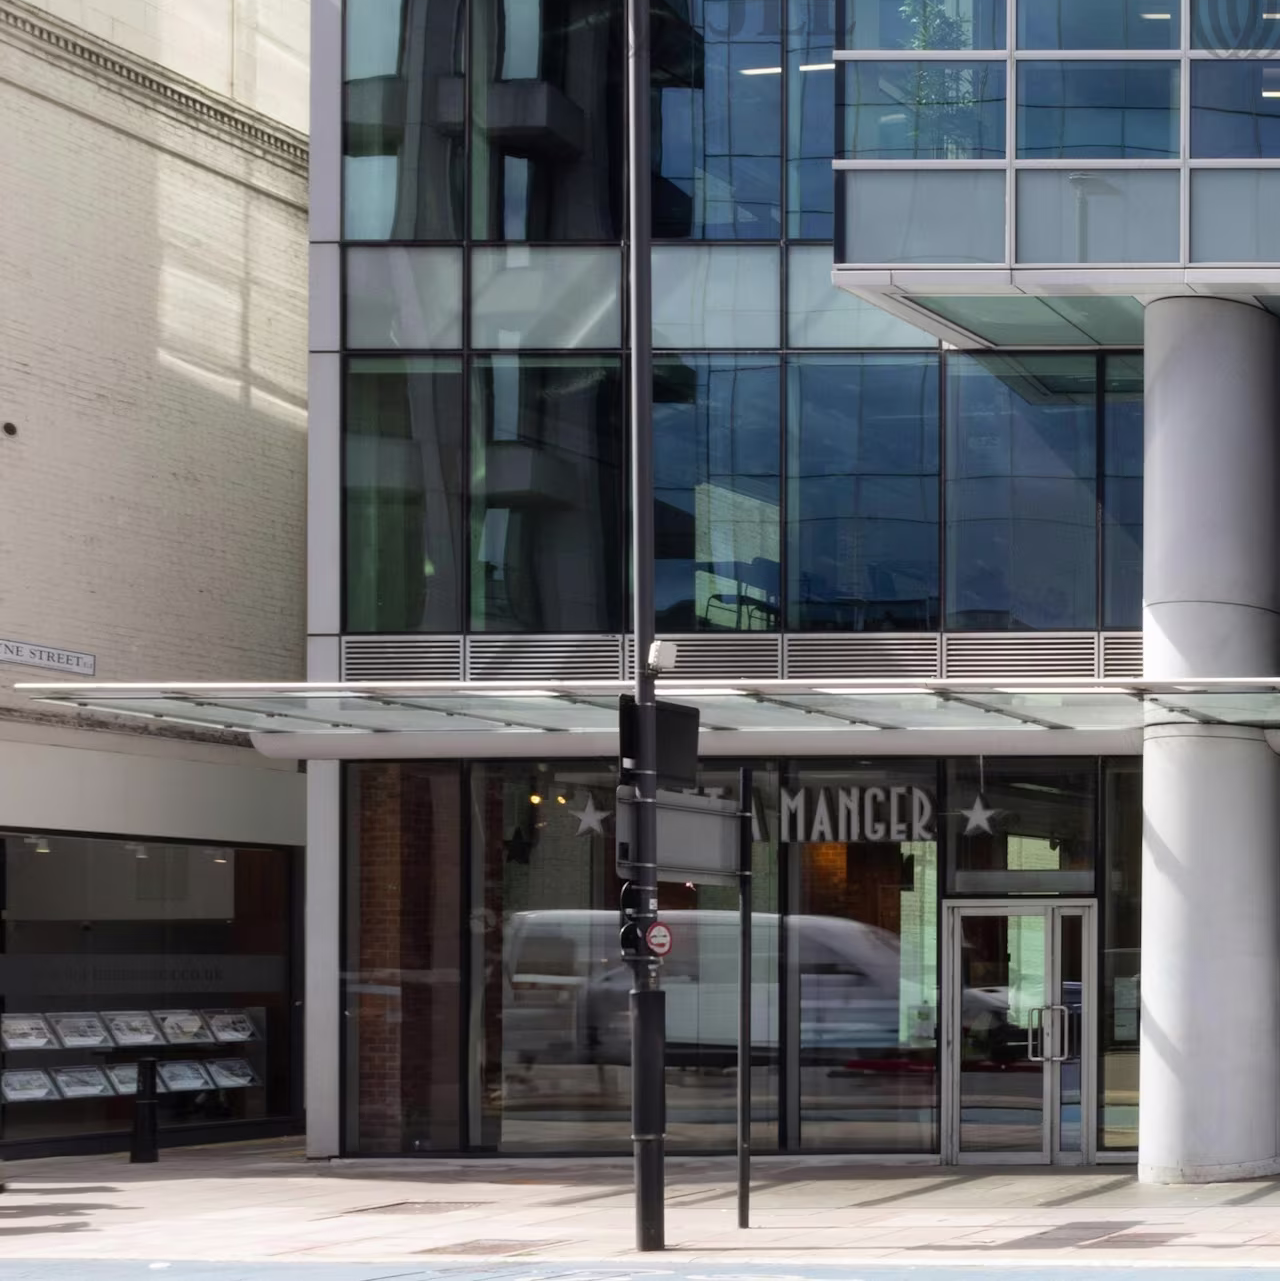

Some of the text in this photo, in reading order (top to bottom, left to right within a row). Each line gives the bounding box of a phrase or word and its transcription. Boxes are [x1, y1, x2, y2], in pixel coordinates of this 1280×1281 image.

[0, 643, 25, 657] NE
[29, 649, 83, 666] STREET
[781, 786, 936, 842] MANGER
